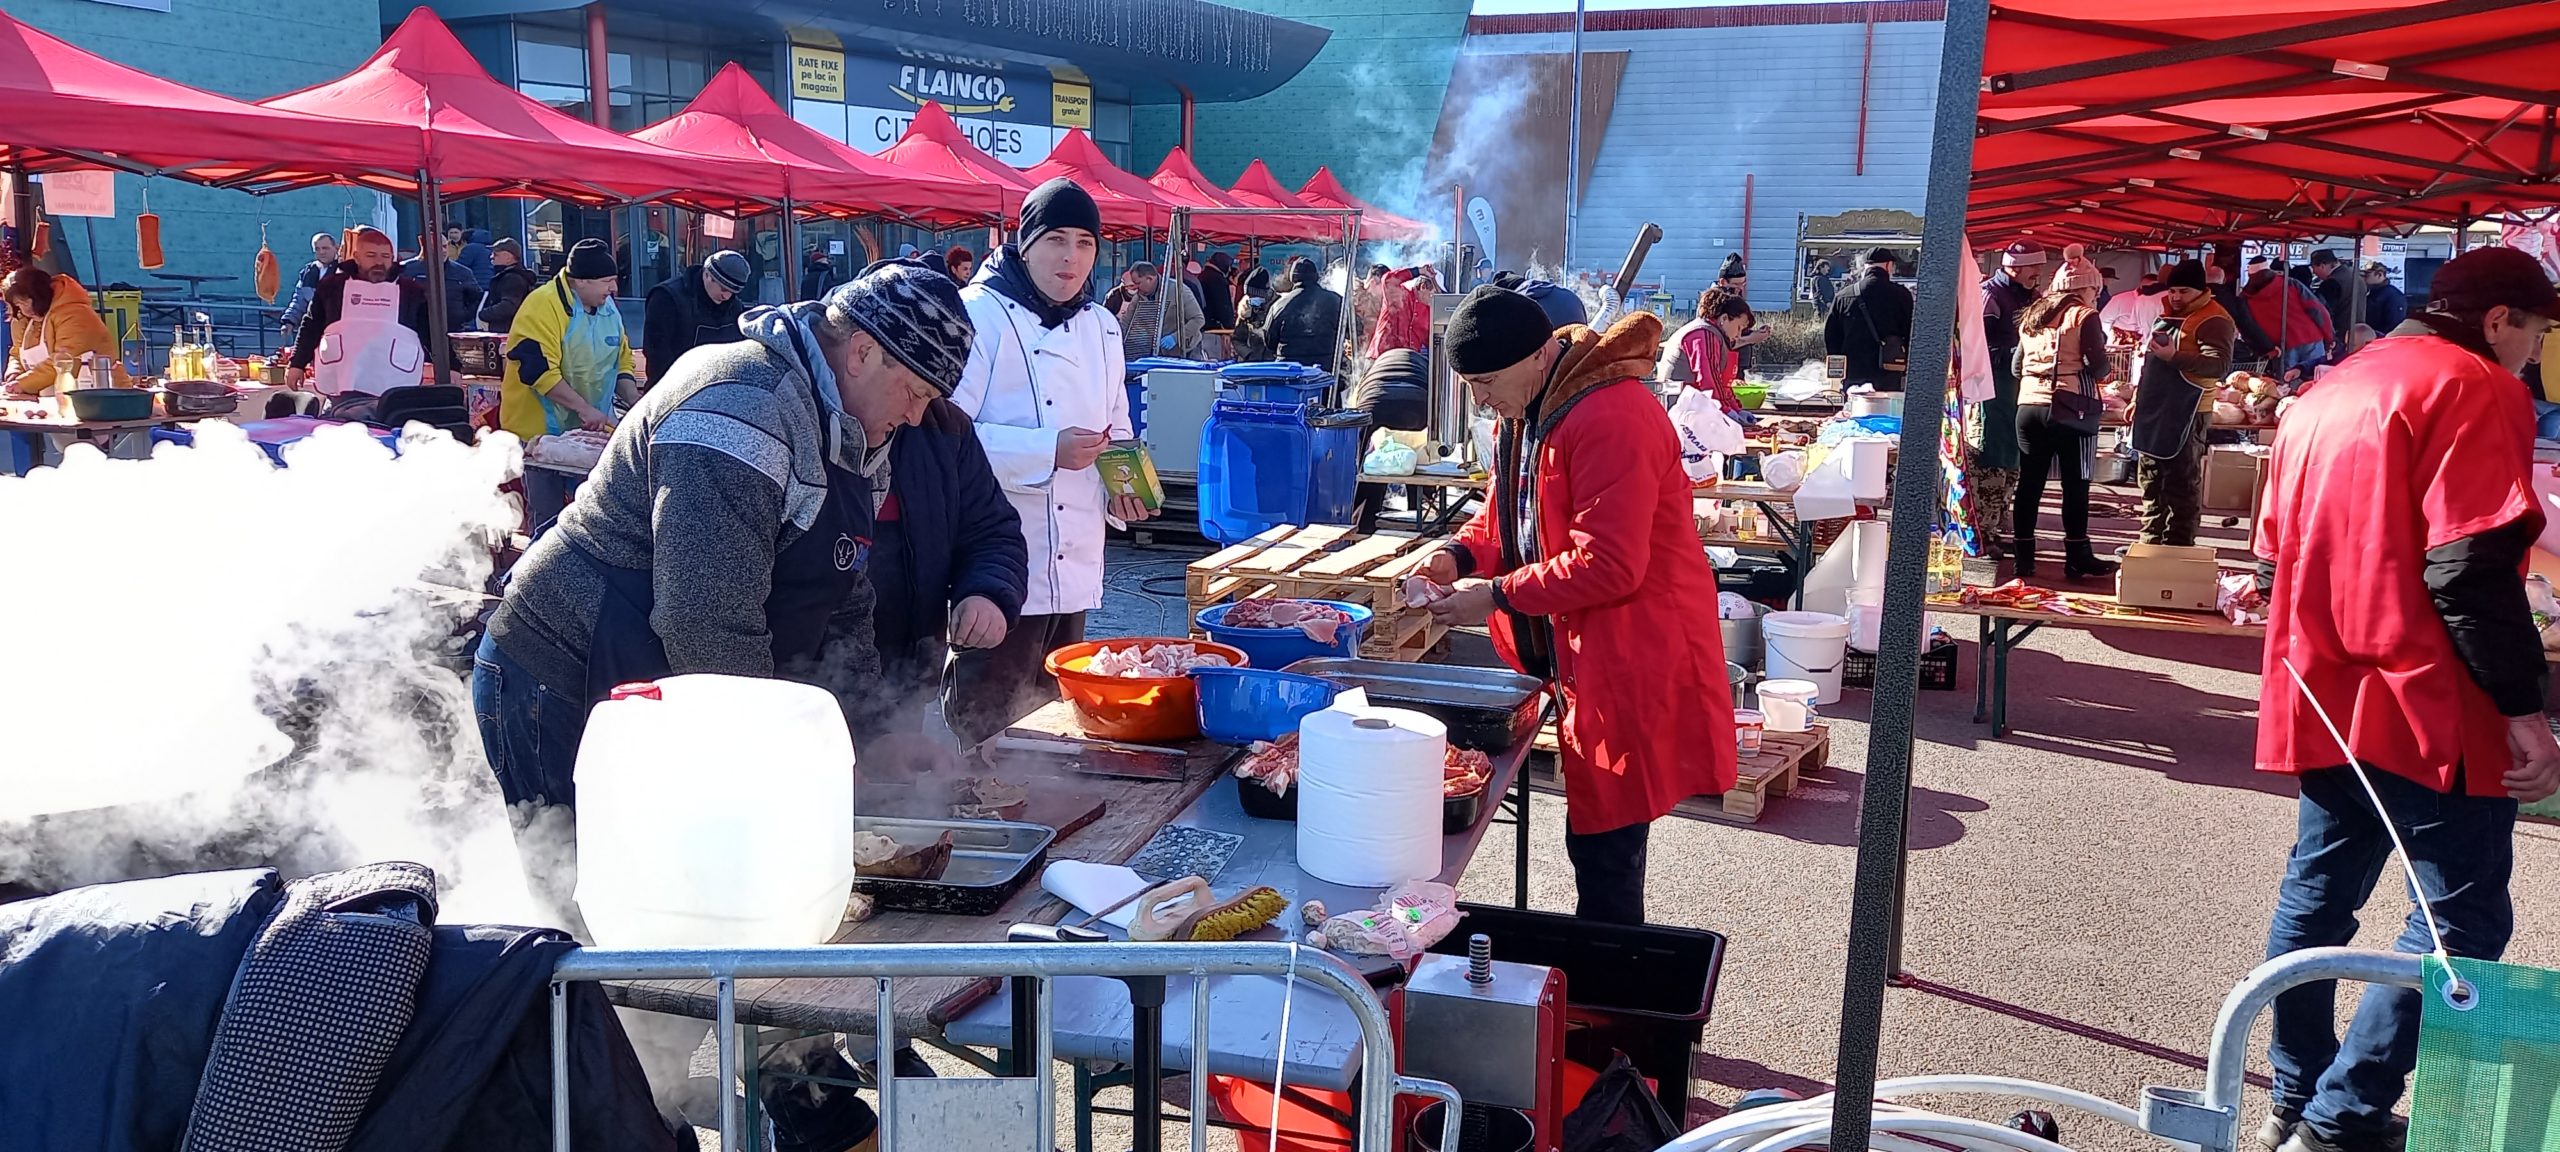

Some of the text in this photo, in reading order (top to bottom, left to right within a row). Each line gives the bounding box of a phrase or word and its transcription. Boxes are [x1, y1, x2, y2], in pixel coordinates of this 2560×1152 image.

[798, 57, 839, 71] RATE FIXE
[801, 71, 812, 81] pe
[814, 69, 826, 81] loc
[800, 82, 838, 93] magazin
[900, 65, 1006, 102] FLANCO
[1054, 94, 1088, 106] TRANSPORT
[874, 115, 1022, 154] CIT HOES
[2262, 243, 2304, 256] STNE
